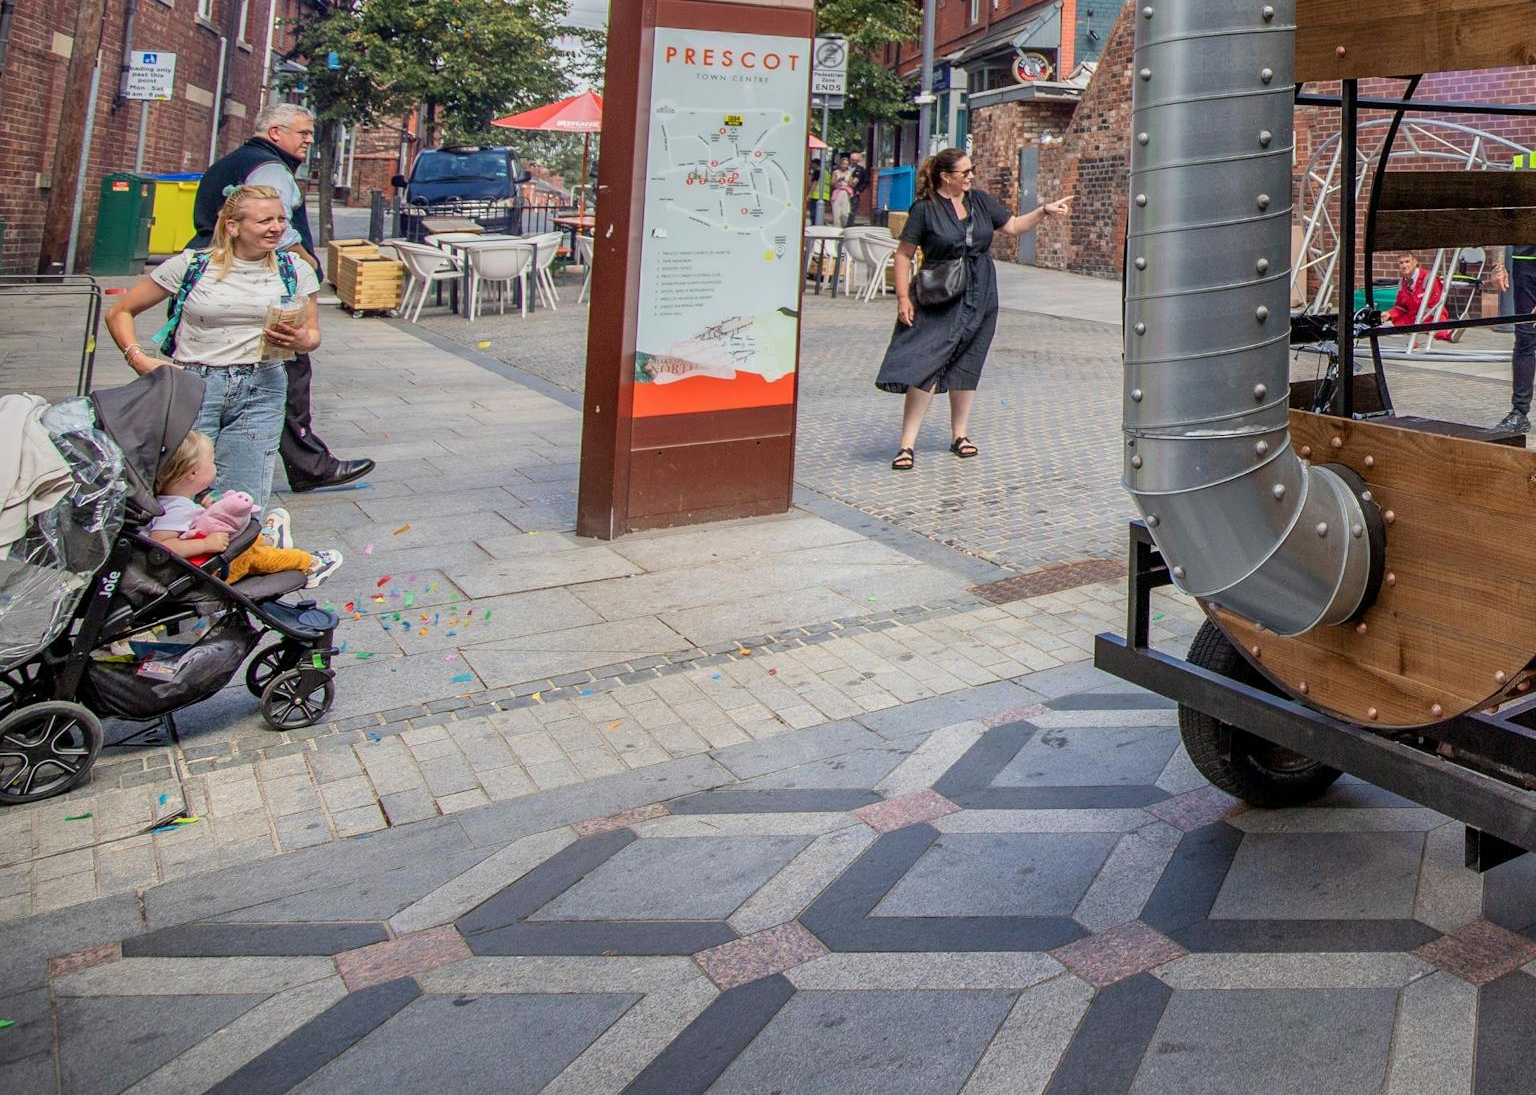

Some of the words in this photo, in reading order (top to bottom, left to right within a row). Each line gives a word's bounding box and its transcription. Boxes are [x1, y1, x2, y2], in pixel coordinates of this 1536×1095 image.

[665, 46, 800, 71] PRESCOT
[696, 73, 727, 81] TOWN
[731, 75, 769, 84] CENTRE
[815, 83, 841, 92] ENDS
[98, 570, 121, 598] Joie
